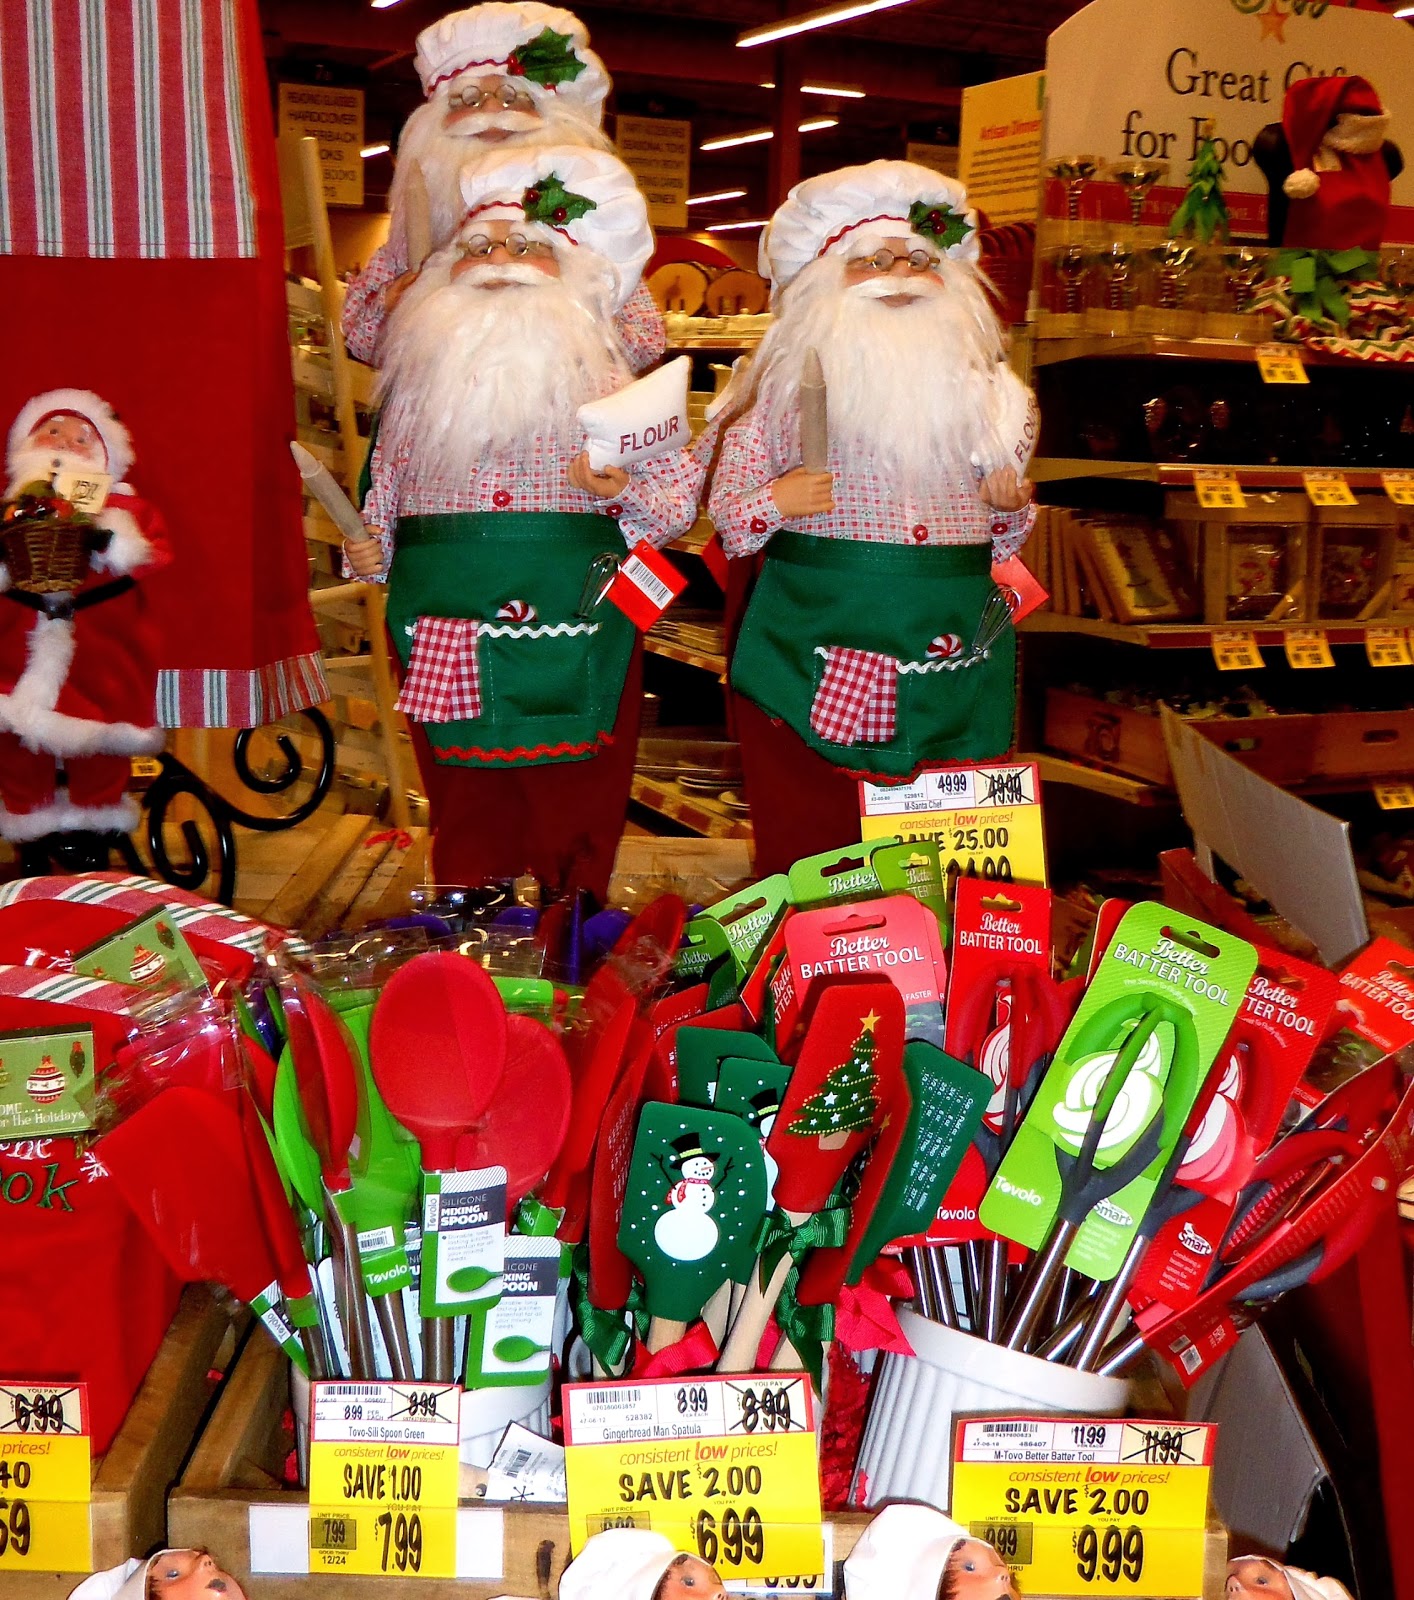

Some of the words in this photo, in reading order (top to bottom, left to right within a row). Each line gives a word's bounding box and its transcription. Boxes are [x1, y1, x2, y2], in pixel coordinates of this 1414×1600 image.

[1165, 47, 1270, 103] Great
[1121, 110, 1176, 159] for
[1187, 117, 1252, 167] Foo
[619, 415, 680, 454] FLOUR
[904, 801, 928, 811] M-Santa
[928, 799, 942, 809] Chef
[900, 816, 951, 830] consistent
[953, 812, 979, 826] low
[979, 811, 1014, 827] prices!
[828, 868, 876, 895] Better
[727, 911, 774, 941] Better
[980, 912, 1021, 934] Better
[829, 935, 890, 957] Better
[960, 930, 1004, 950] BATTER
[1006, 936, 1042, 955] TOOL
[800, 956, 870, 979] BATTER
[873, 946, 925, 968] TOOL
[1151, 938, 1210, 976] Better
[1113, 943, 1182, 984] BATTER
[1183, 972, 1229, 1007] TOOL
[906, 990, 932, 1001] FASTER
[1248, 976, 1299, 1010] Better
[1339, 972, 1389, 1003] BATTER
[1385, 996, 1414, 1026] TOO
[1276, 1008, 1316, 1037] TOOL
[13, 1114, 31, 1126] the
[35, 1109, 86, 1124] Holidays
[0, 1163, 79, 1212] ok
[441, 1194, 487, 1206] SILICONE
[995, 1175, 1043, 1207] Tovolo
[427, 1198, 438, 1228] Tovolo
[440, 1211, 489, 1226] SPOON
[441, 1205, 480, 1216] MIXING
[366, 1264, 408, 1285] Tovolo
[503, 1281, 538, 1292] POON
[267, 1313, 288, 1341] Tovolo
[349, 1426, 379, 1438] Tovo-Sili
[380, 1426, 403, 1442] Spoon
[405, 1428, 425, 1439] Green
[603, 1426, 651, 1442] Gingerbread
[653, 1424, 670, 1436] Man
[671, 1423, 702, 1440] Spatula
[1, 1441, 51, 1457] prices!
[334, 1446, 384, 1458] consistent
[386, 1445, 410, 1459] low
[411, 1449, 445, 1461] prices!
[620, 1448, 690, 1466] consistent
[694, 1442, 728, 1461] low
[731, 1441, 778, 1461] prices!
[994, 1450, 1023, 1460] M-Tovo
[1025, 1451, 1049, 1461] Better
[1051, 1452, 1075, 1461] Batter
[1078, 1452, 1095, 1461] Tool
[343, 1463, 386, 1500] SAVE
[619, 1470, 693, 1502] SAVE
[1009, 1469, 1083, 1483] consistent
[1085, 1466, 1120, 1483] low
[1121, 1471, 1171, 1487] prices!
[1005, 1488, 1078, 1515] SAVE
[322, 1556, 347, 1565] 12/24
